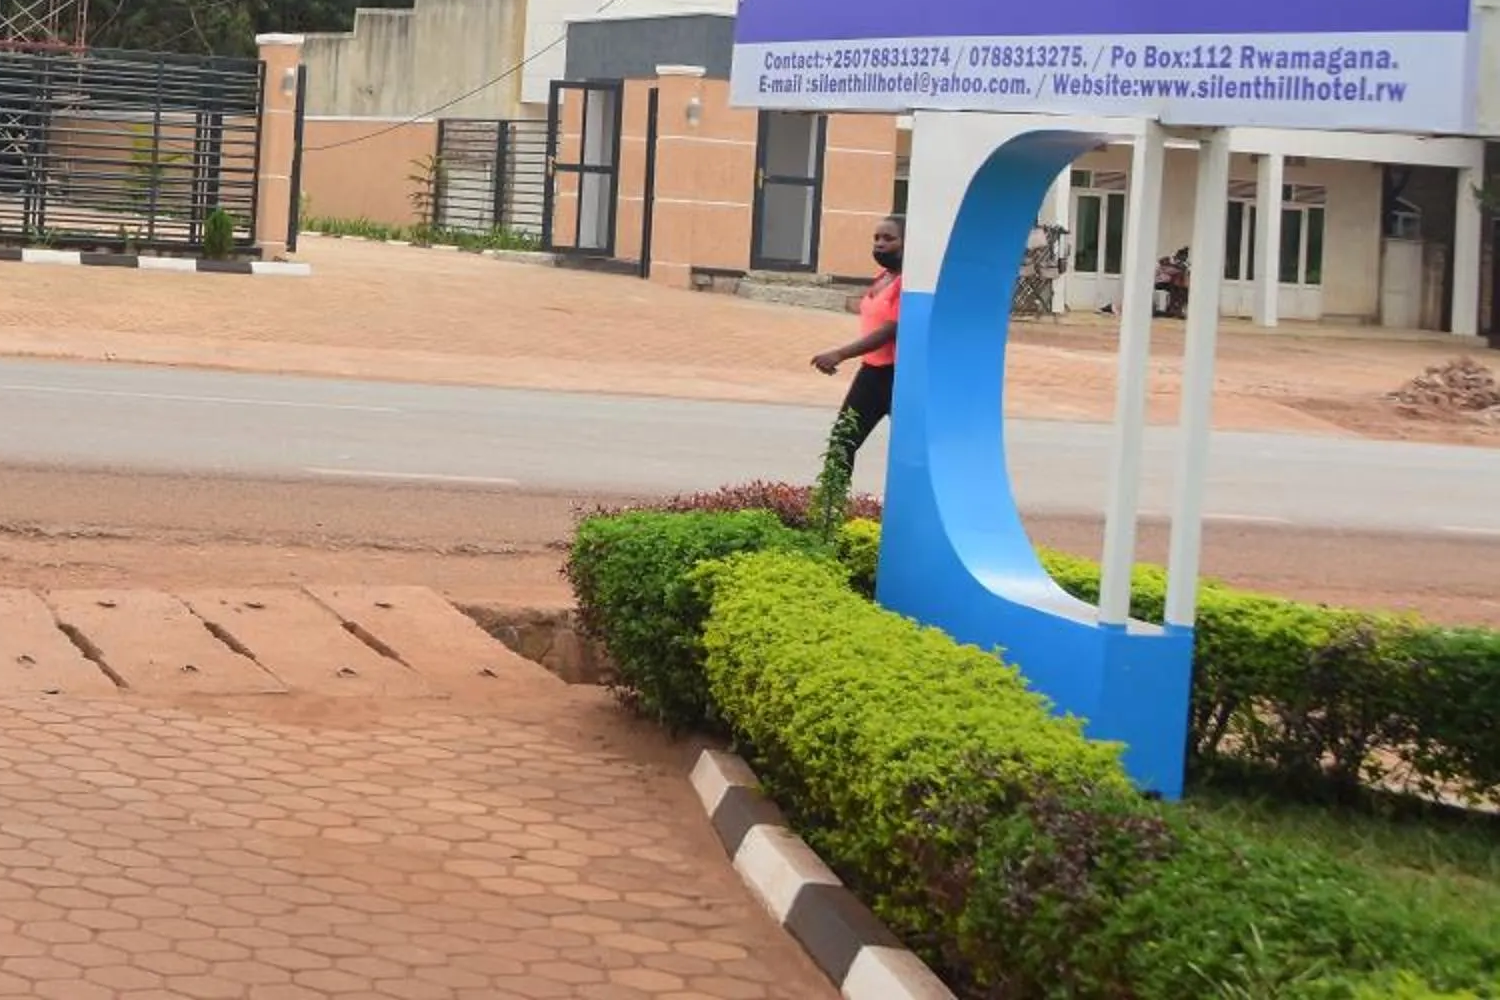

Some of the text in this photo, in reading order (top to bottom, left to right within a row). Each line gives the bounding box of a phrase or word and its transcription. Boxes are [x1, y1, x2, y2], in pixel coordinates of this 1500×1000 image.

[969, 45, 1088, 68] 0788313275.
[1111, 46, 1137, 67] Po
[1143, 46, 1232, 70] Box:112
[1239, 48, 1398, 74] Rwamagana.
